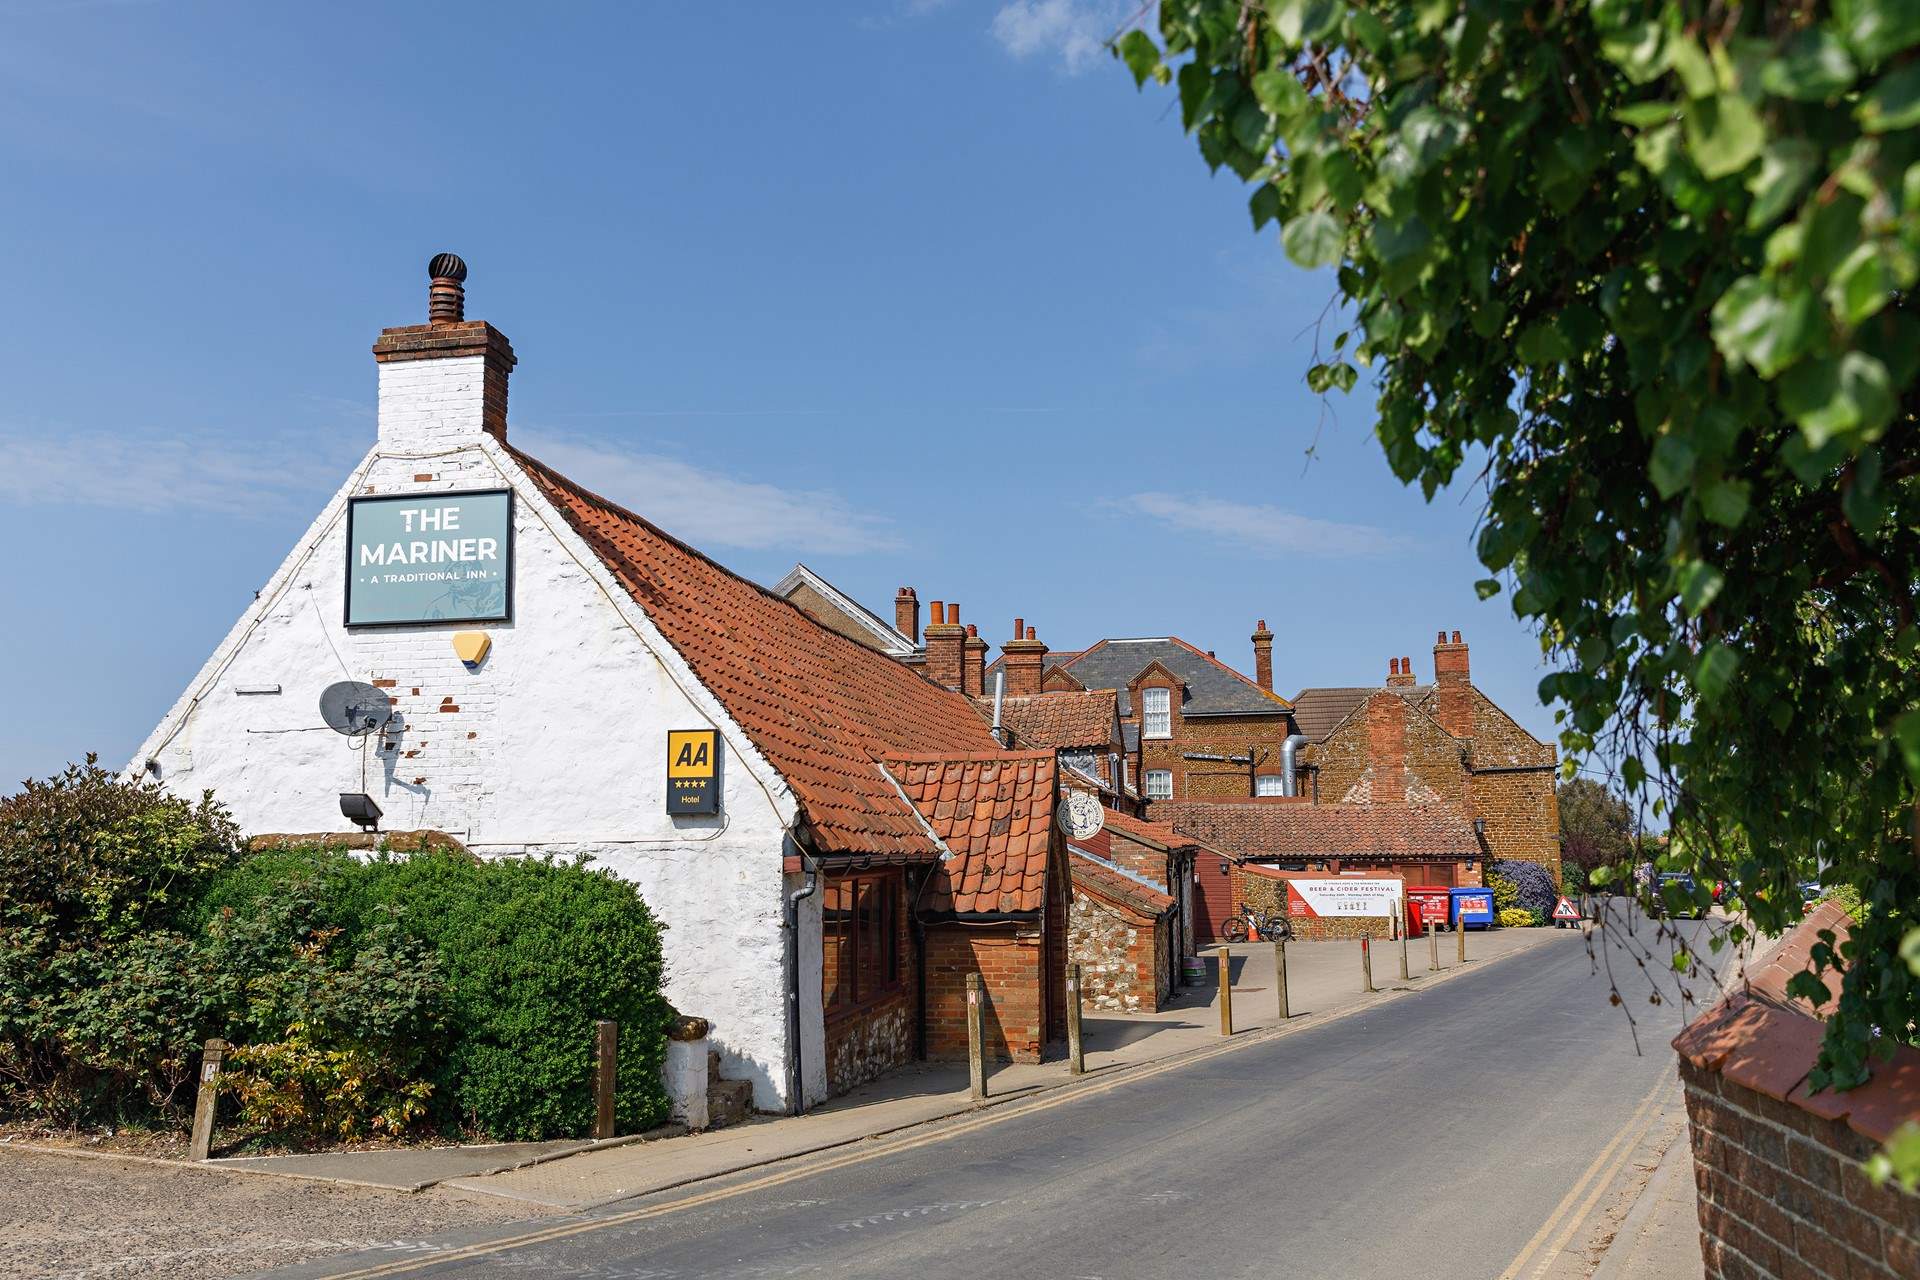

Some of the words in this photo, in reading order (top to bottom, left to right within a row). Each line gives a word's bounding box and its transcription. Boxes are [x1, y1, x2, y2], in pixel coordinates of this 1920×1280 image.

[400, 506, 460, 533] THE
[360, 537, 497, 567] MARINER
[370, 575, 379, 584] A
[383, 571, 460, 583] TRADITIONAL
[466, 570, 487, 579] INN
[675, 742, 708, 767] AA
[681, 796, 700, 804] Hotel
